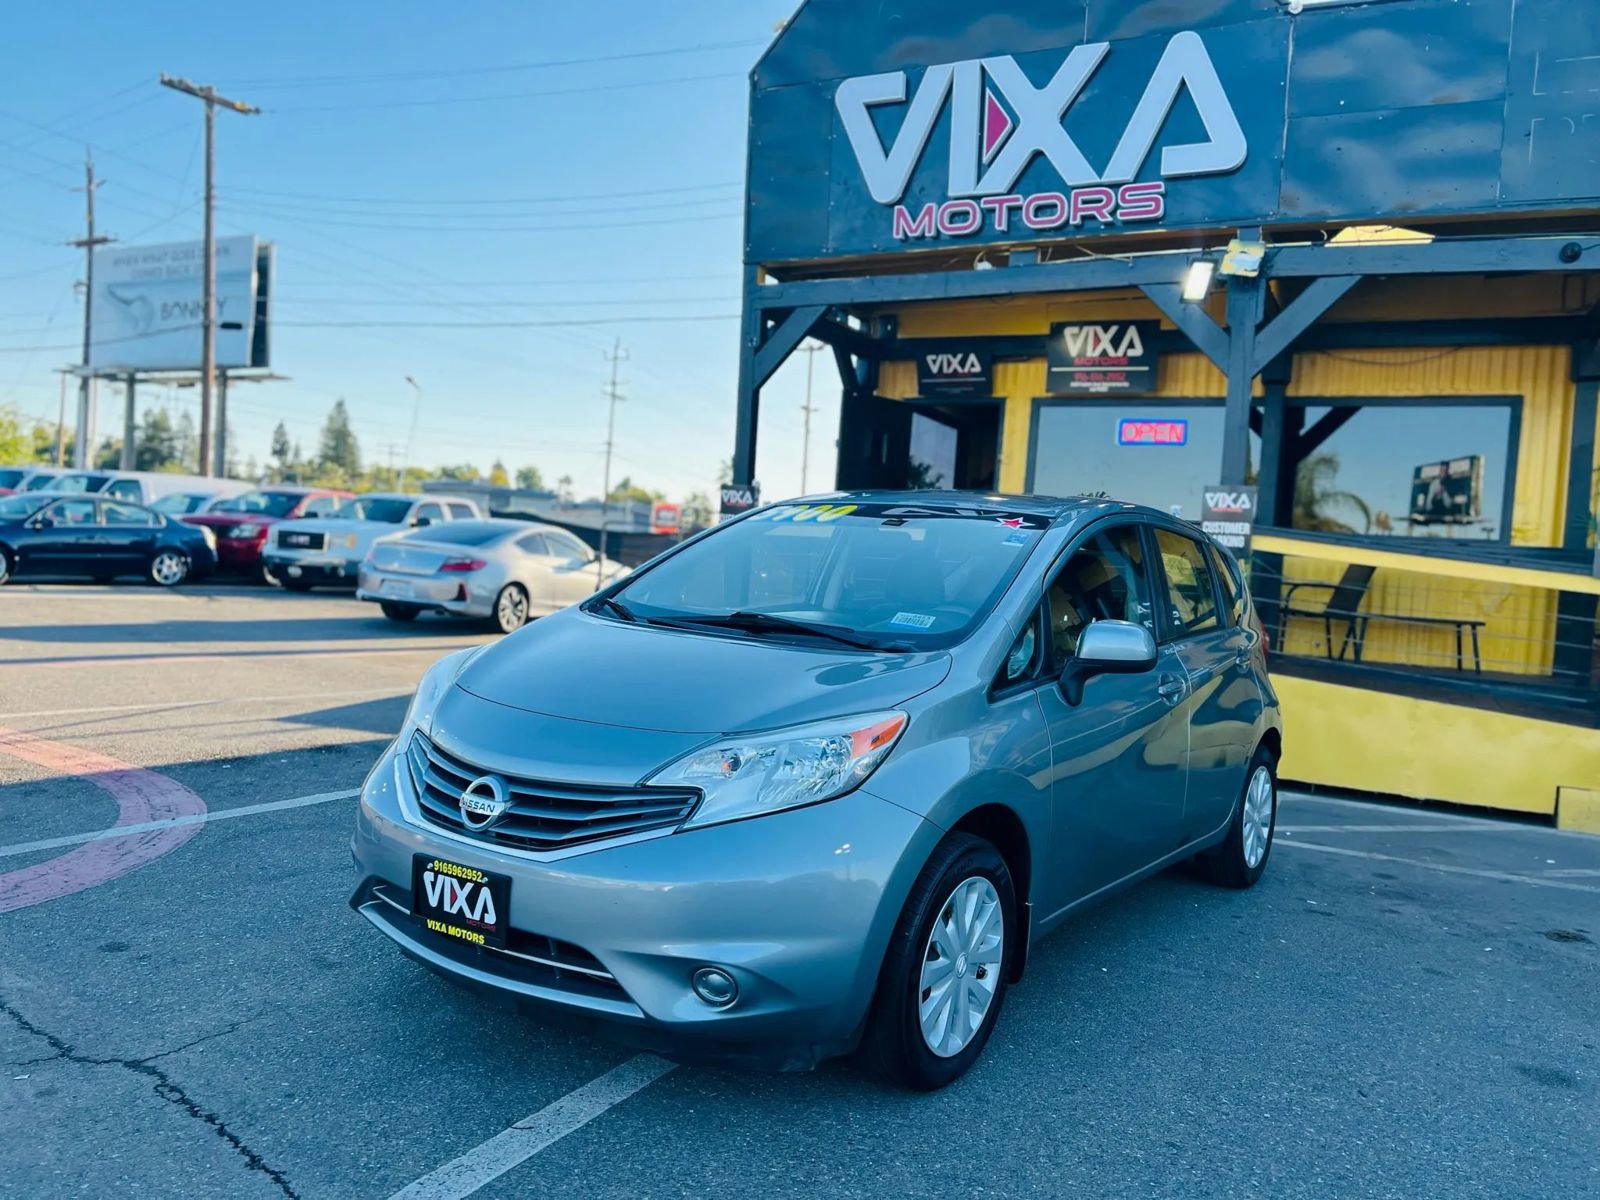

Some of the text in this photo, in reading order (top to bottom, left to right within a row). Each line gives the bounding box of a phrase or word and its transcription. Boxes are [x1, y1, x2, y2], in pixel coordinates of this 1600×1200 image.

[835, 30, 1248, 205] VIXA
[893, 181, 1166, 240] MOTORS
[1063, 325, 1144, 358] VIXA
[925, 352, 983, 375] VIXA
[1122, 422, 1185, 443] OPEN
[722, 489, 753, 504] VIXA
[1204, 492, 1251, 509] VIXA
[1202, 521, 1251, 535] CUSTOMER
[433, 860, 483, 883] 9165962952
[423, 871, 497, 925] VIXA
[427, 919, 485, 945] VIXA MOTORS
